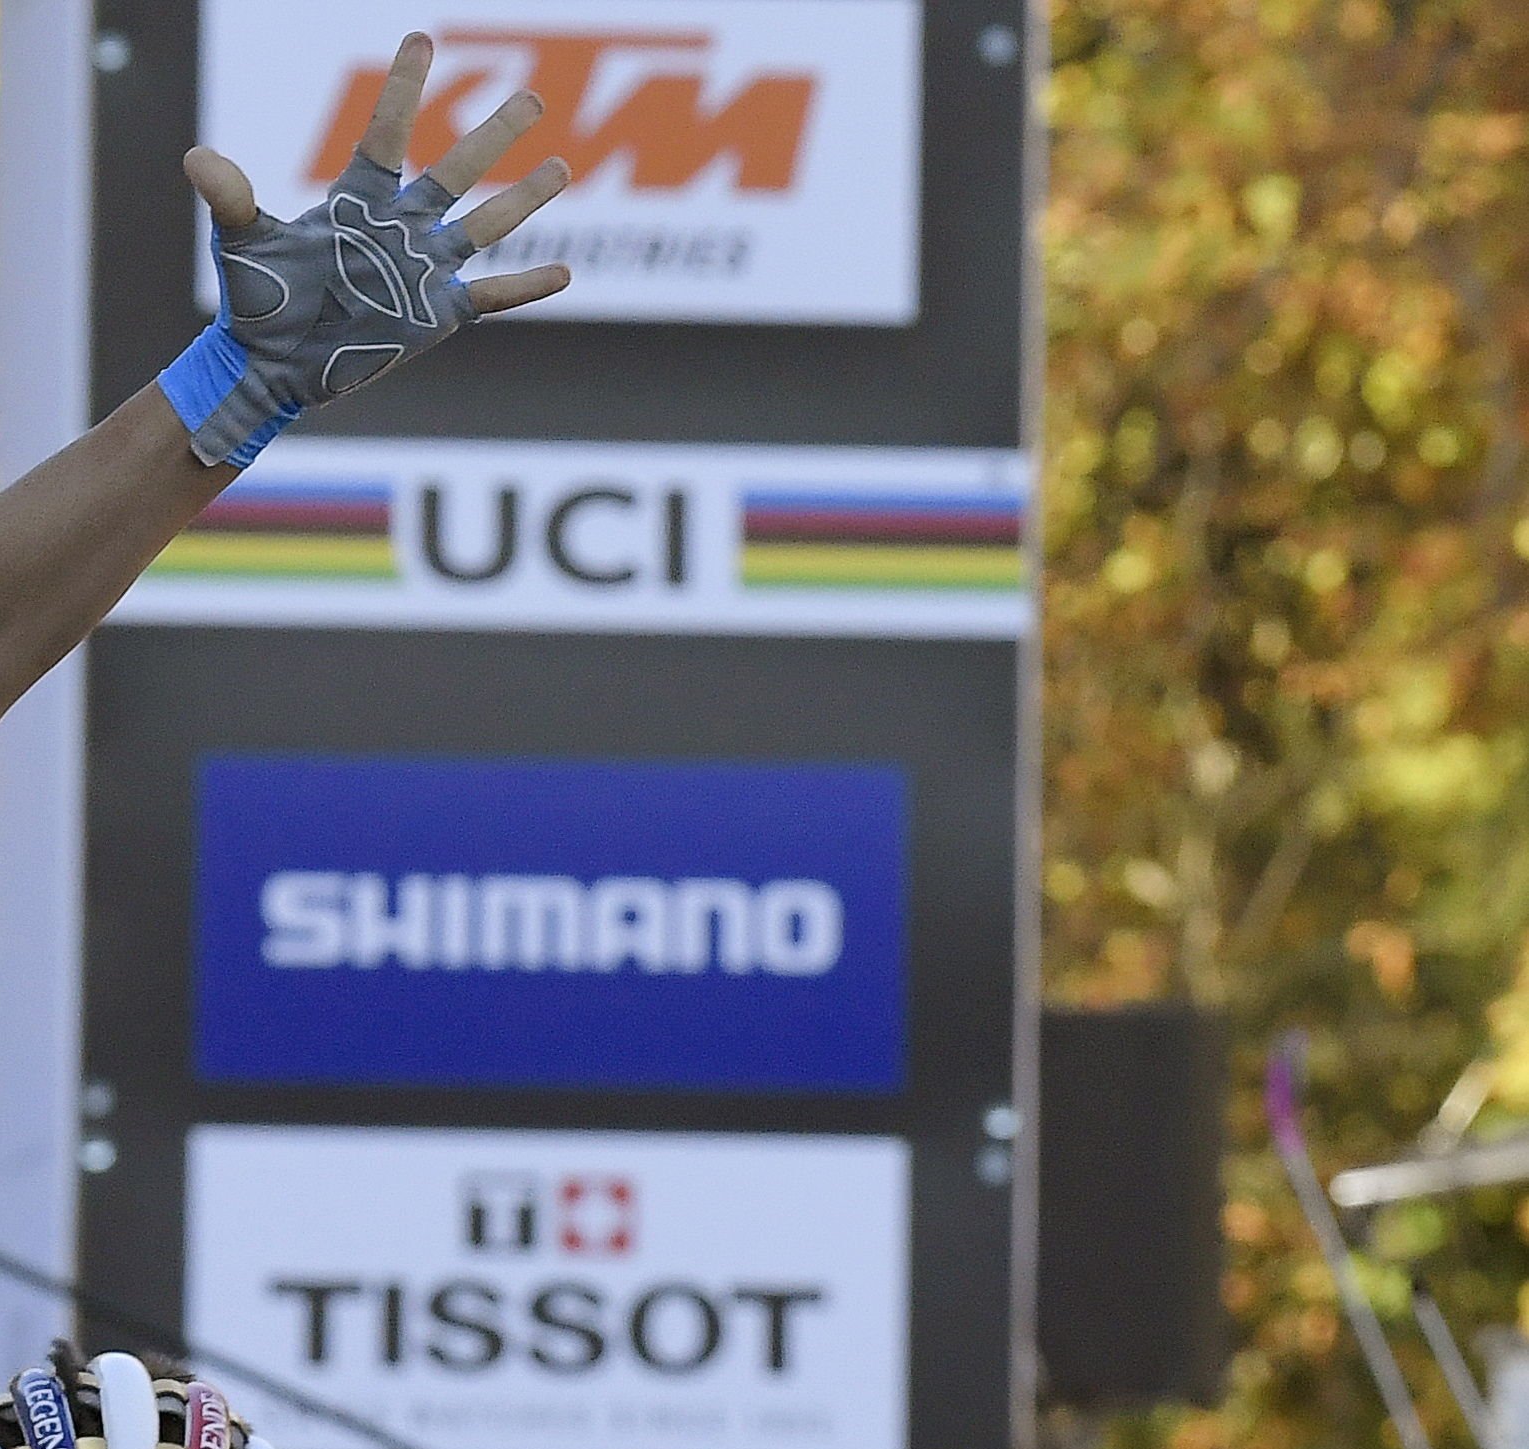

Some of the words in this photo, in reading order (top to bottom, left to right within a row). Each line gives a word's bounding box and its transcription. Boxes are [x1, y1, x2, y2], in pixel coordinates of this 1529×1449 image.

[302, 29, 821, 194] KTM
[418, 483, 690, 586] UCI
[258, 870, 845, 976] SHIMANO
[271, 1276, 824, 1376] TISSOT
